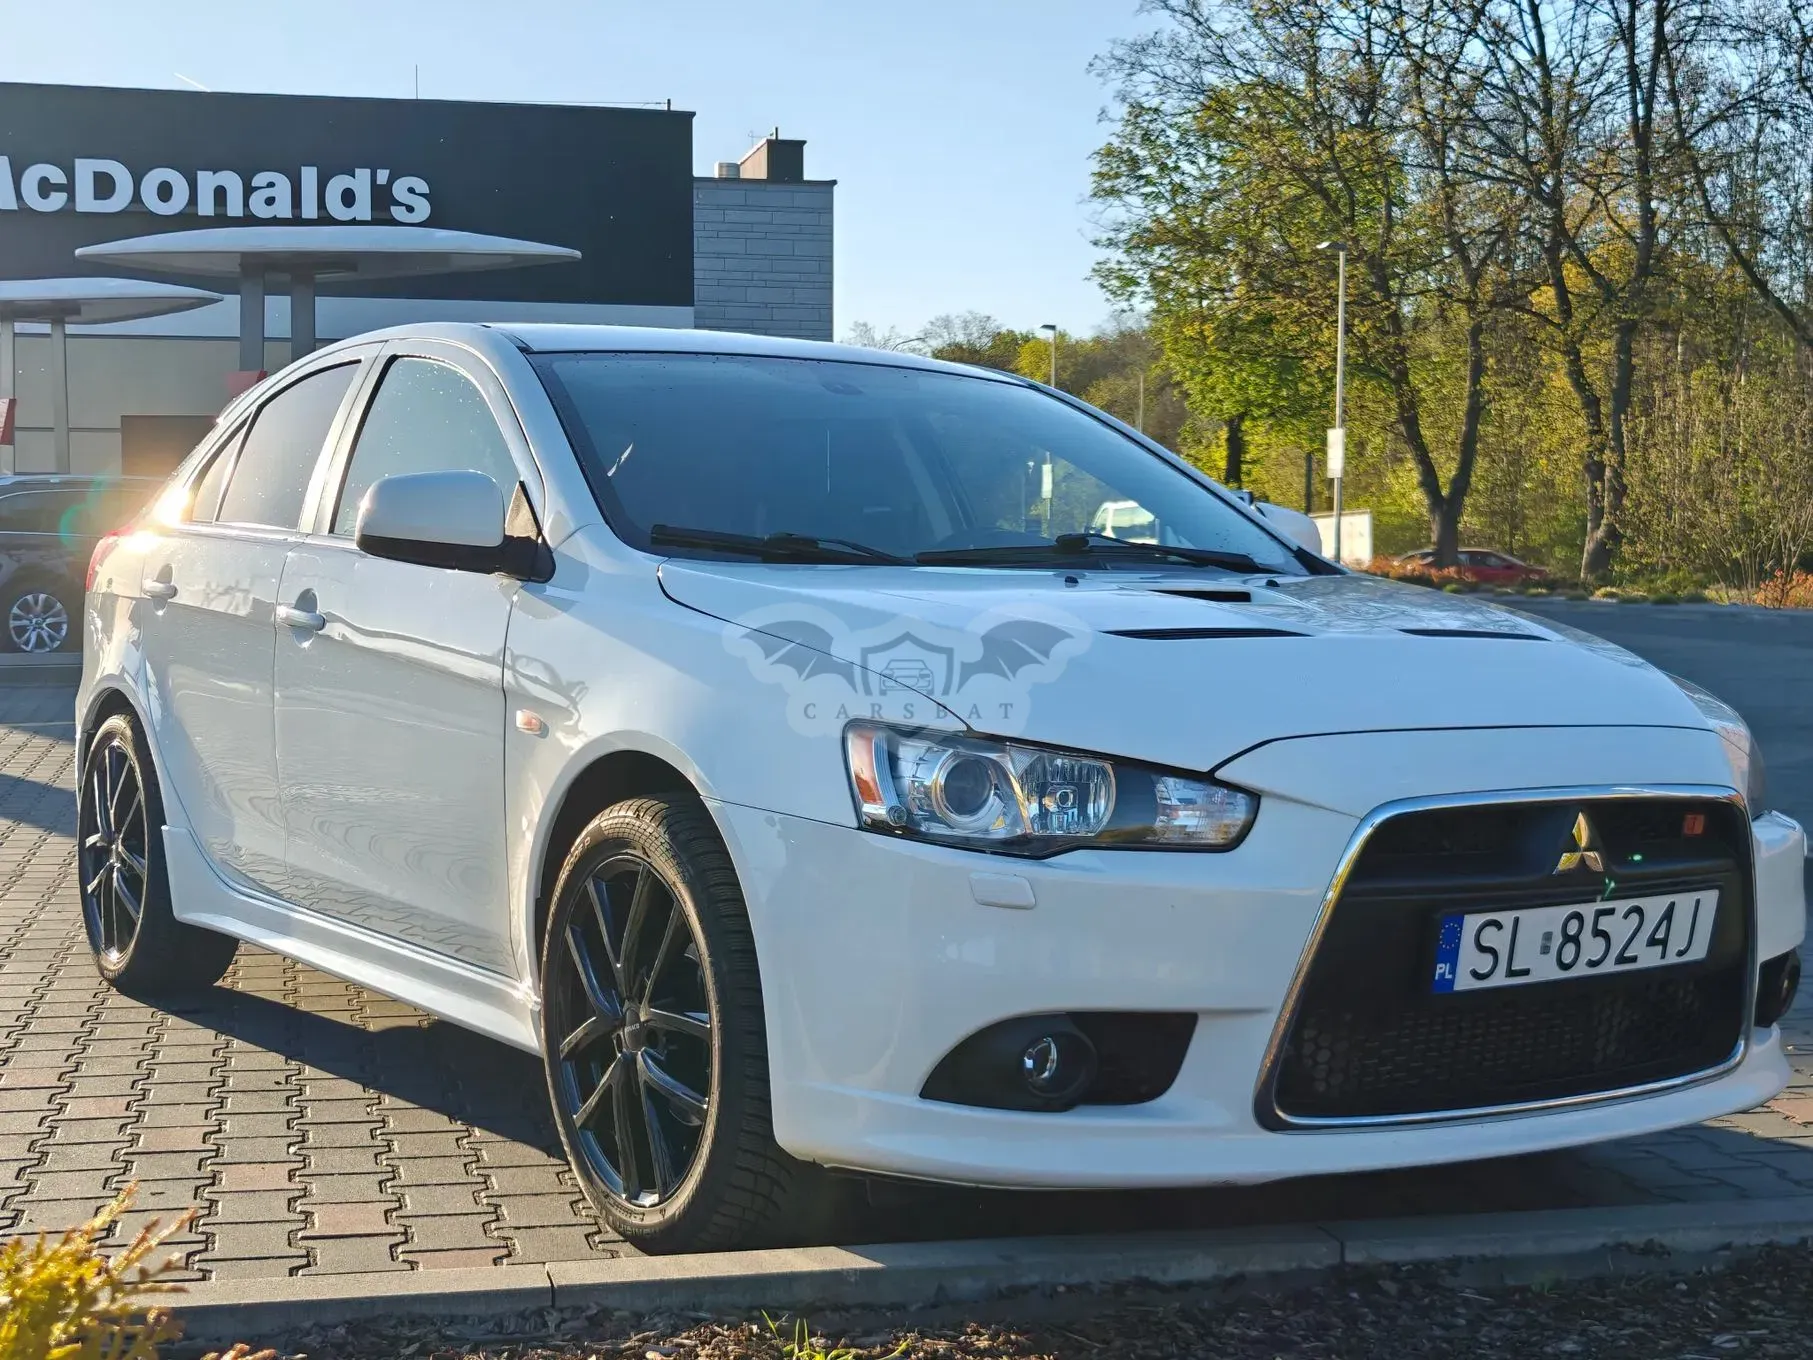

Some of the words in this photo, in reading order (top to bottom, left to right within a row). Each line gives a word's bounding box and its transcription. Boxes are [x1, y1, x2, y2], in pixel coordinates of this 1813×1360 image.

[1469, 916, 1531, 980] SL
[1556, 898, 1700, 971] 8524J
[1435, 962, 1453, 980] PL
